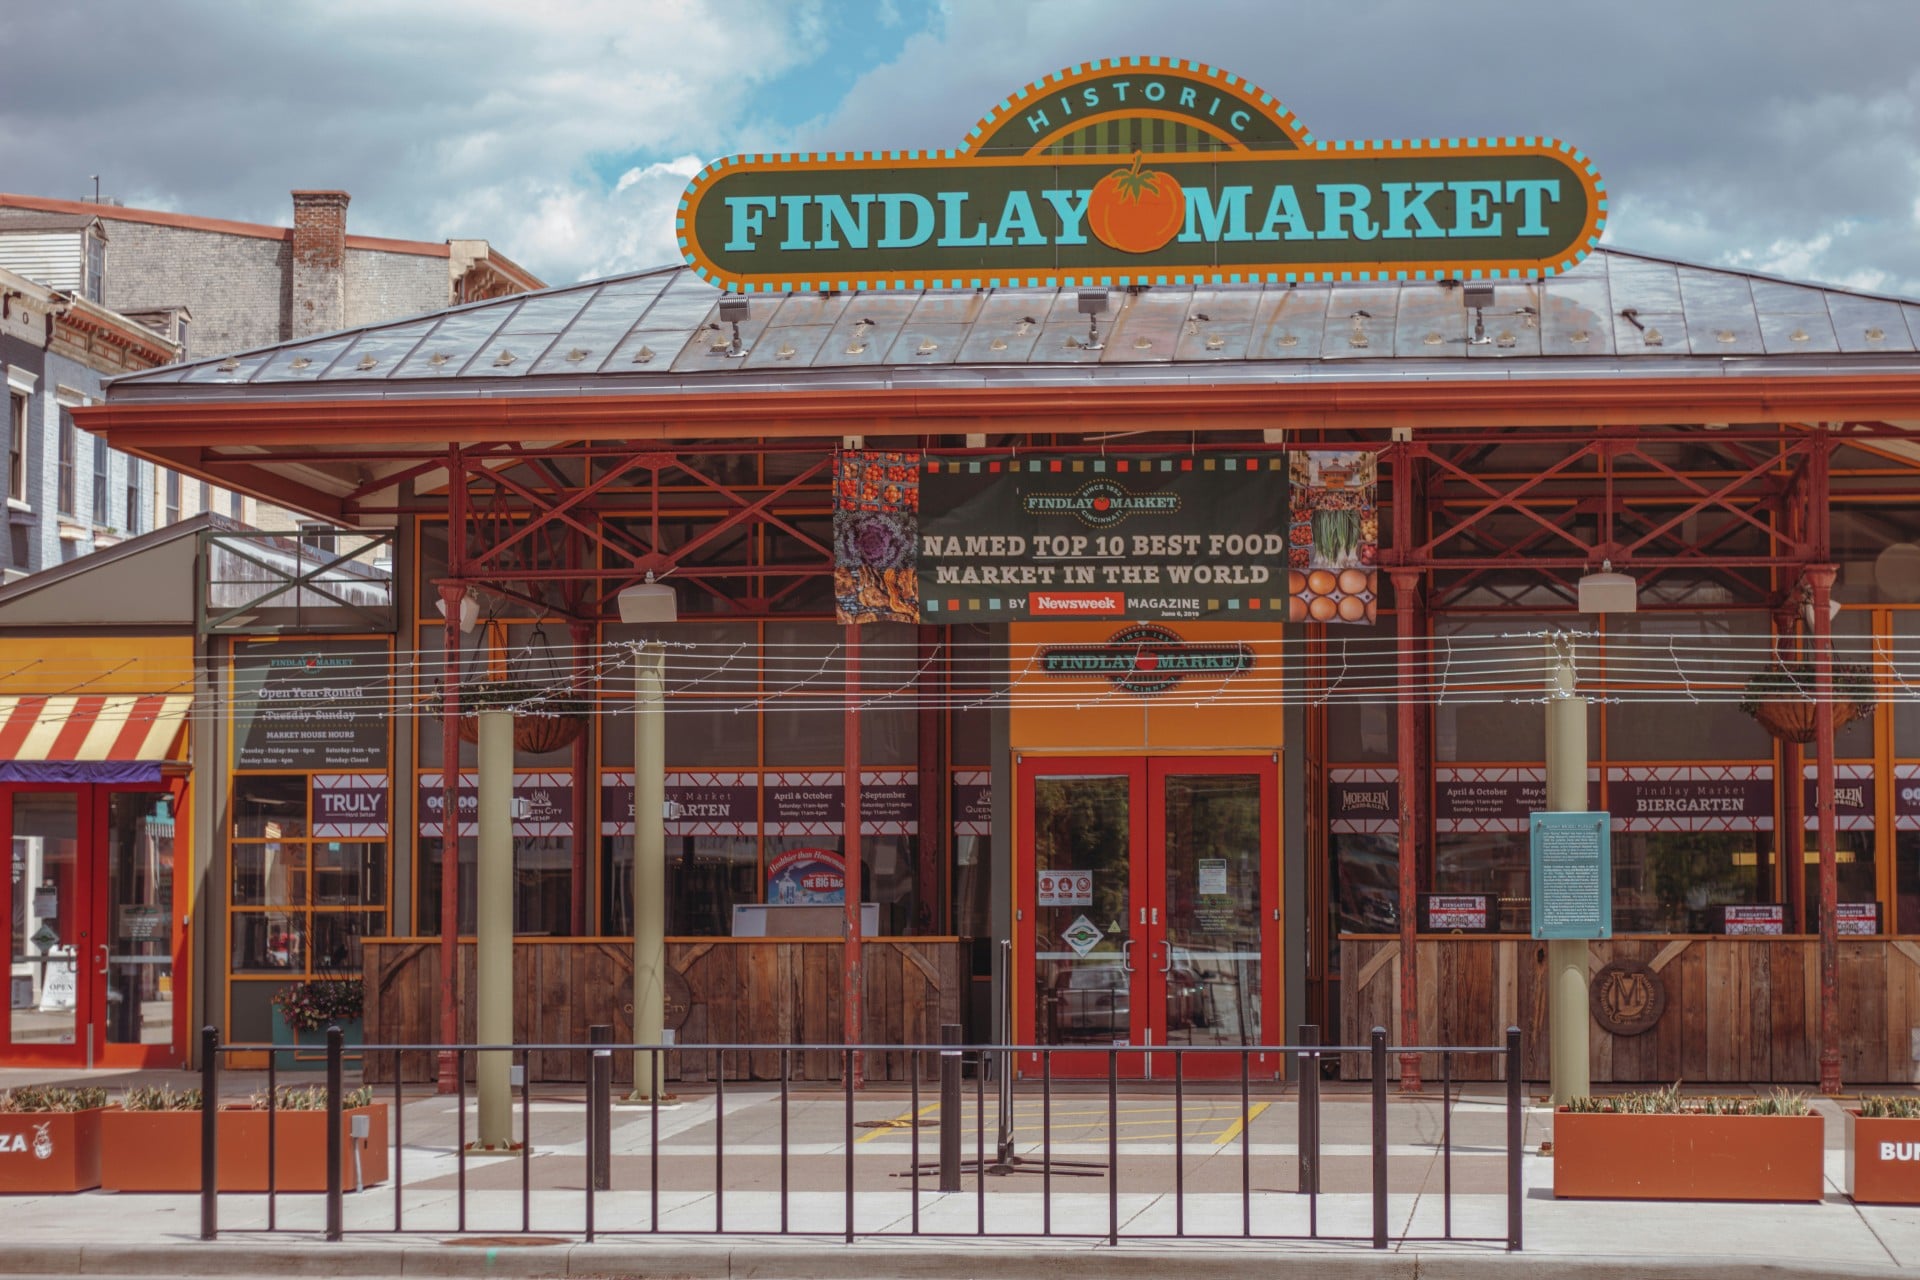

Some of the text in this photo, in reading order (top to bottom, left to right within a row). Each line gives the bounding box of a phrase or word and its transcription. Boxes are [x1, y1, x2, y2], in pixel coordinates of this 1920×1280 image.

[1026, 82, 1251, 133] HISTORIC
[724, 179, 1561, 252] FINDLAY MARKET
[1083, 484, 1104, 498] SINCE
[1028, 497, 1177, 509] FINDLAY MARKET
[1081, 509, 1123, 523] CINCINNATI
[922, 534, 1283, 556] NAMED TOP 10 BEST FOOD
[936, 565, 1269, 584] MARKET IN THE WORLD
[1009, 597, 1200, 609] BY Newsweek MAGAZINE
[271, 658, 353, 667] FINDLAY MARKET
[1047, 654, 1248, 669] FINDLAY MARKET
[258, 687, 290, 700] Open
[266, 731, 299, 739] MARKET
[686, 793, 732, 801] Market
[774, 792, 794, 801] April
[802, 792, 832, 800] October
[1447, 788, 1467, 797] April
[1476, 788, 1507, 796] October
[1636, 786, 1745, 796] Findlay Market
[321, 793, 381, 811] TRULY
[1342, 790, 1389, 810] MOERLEIN
[1636, 798, 1745, 812] BIERGARTEN
[769, 854, 798, 873] Healthier
[797, 851, 812, 860] than
[803, 876, 844, 888] THE BIG BAG
